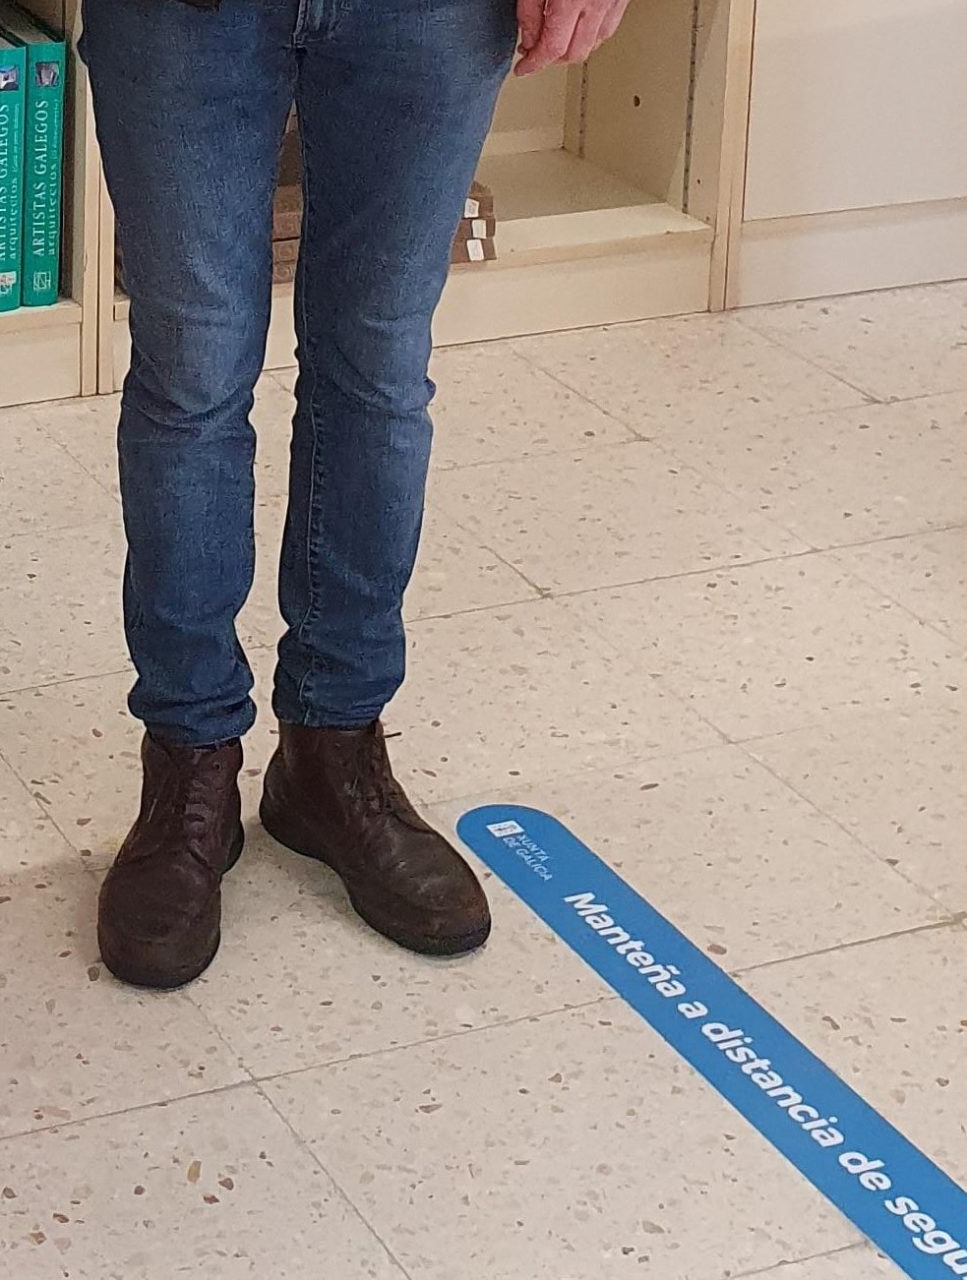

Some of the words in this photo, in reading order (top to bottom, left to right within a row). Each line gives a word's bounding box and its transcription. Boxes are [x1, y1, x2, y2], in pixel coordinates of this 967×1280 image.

[34, 100, 49, 176] GALEGOS
[9, 177, 19, 260] arquitectos
[32, 181, 46, 257] ARTISTAS
[48, 163, 57, 256] arquitectos
[503, 837, 517, 848] DE
[516, 848, 553, 882] GALICIA
[516, 834, 550, 863] XUNTA
[563, 892, 687, 998] Manteña
[677, 1000, 709, 1019] a
[701, 1022, 845, 1148] distancia
[838, 1151, 892, 1192] de
[884, 1195, 967, 1280] segu
